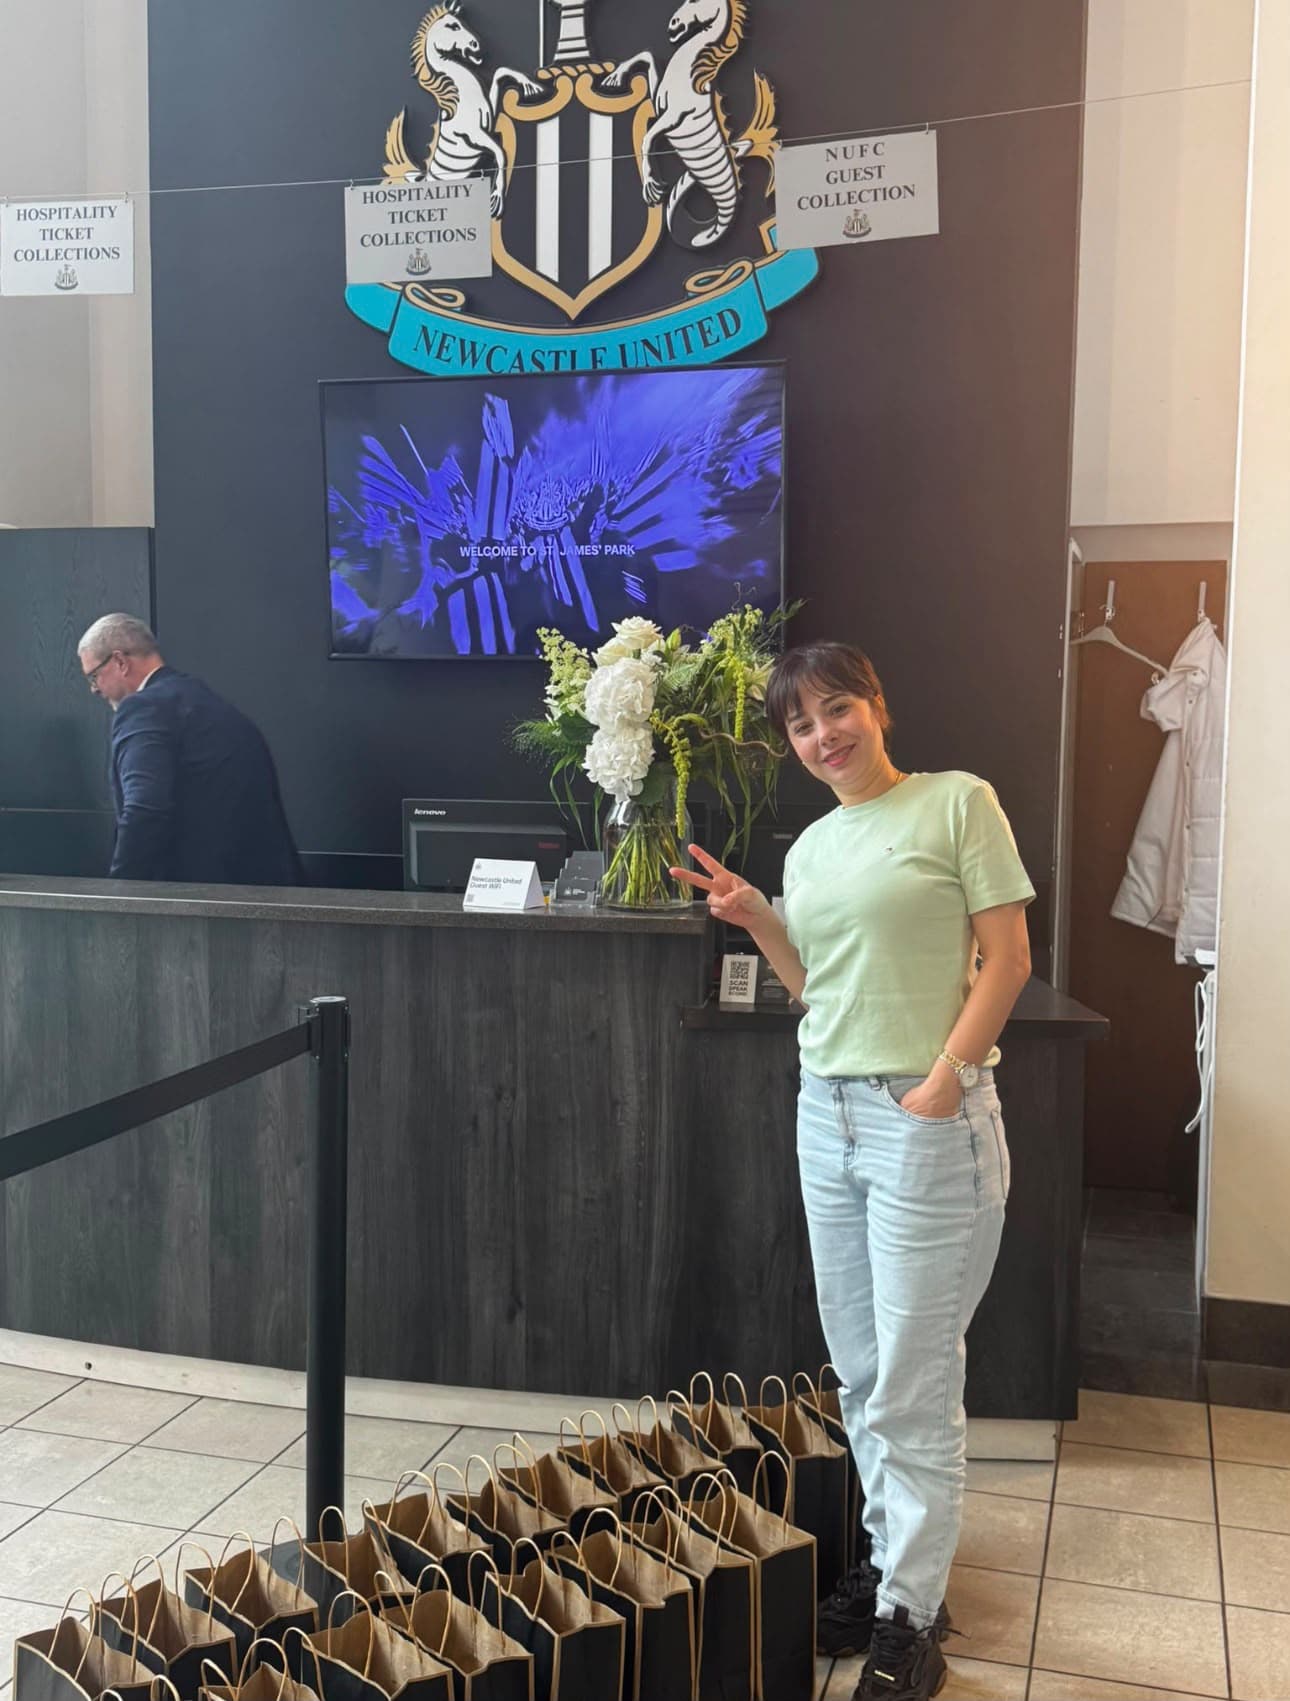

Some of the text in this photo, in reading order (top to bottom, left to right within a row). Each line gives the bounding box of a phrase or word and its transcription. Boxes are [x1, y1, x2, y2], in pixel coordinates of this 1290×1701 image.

[826, 165, 886, 185] GUEST
[363, 184, 473, 204] HOSPITALITY
[797, 184, 915, 210] COLLECTION
[16, 205, 118, 221] HOSPITALITY
[388, 208, 448, 224] TICKET
[39, 227, 94, 241] TICKET
[360, 227, 477, 247] COLLECTIONS
[14, 246, 121, 262] COLLECTIONS
[617, 308, 742, 369] UNITED
[460, 545, 518, 557] WELCOME
[520, 545, 537, 556] TO
[604, 544, 636, 556] PARK
[414, 807, 447, 816] lenovo
